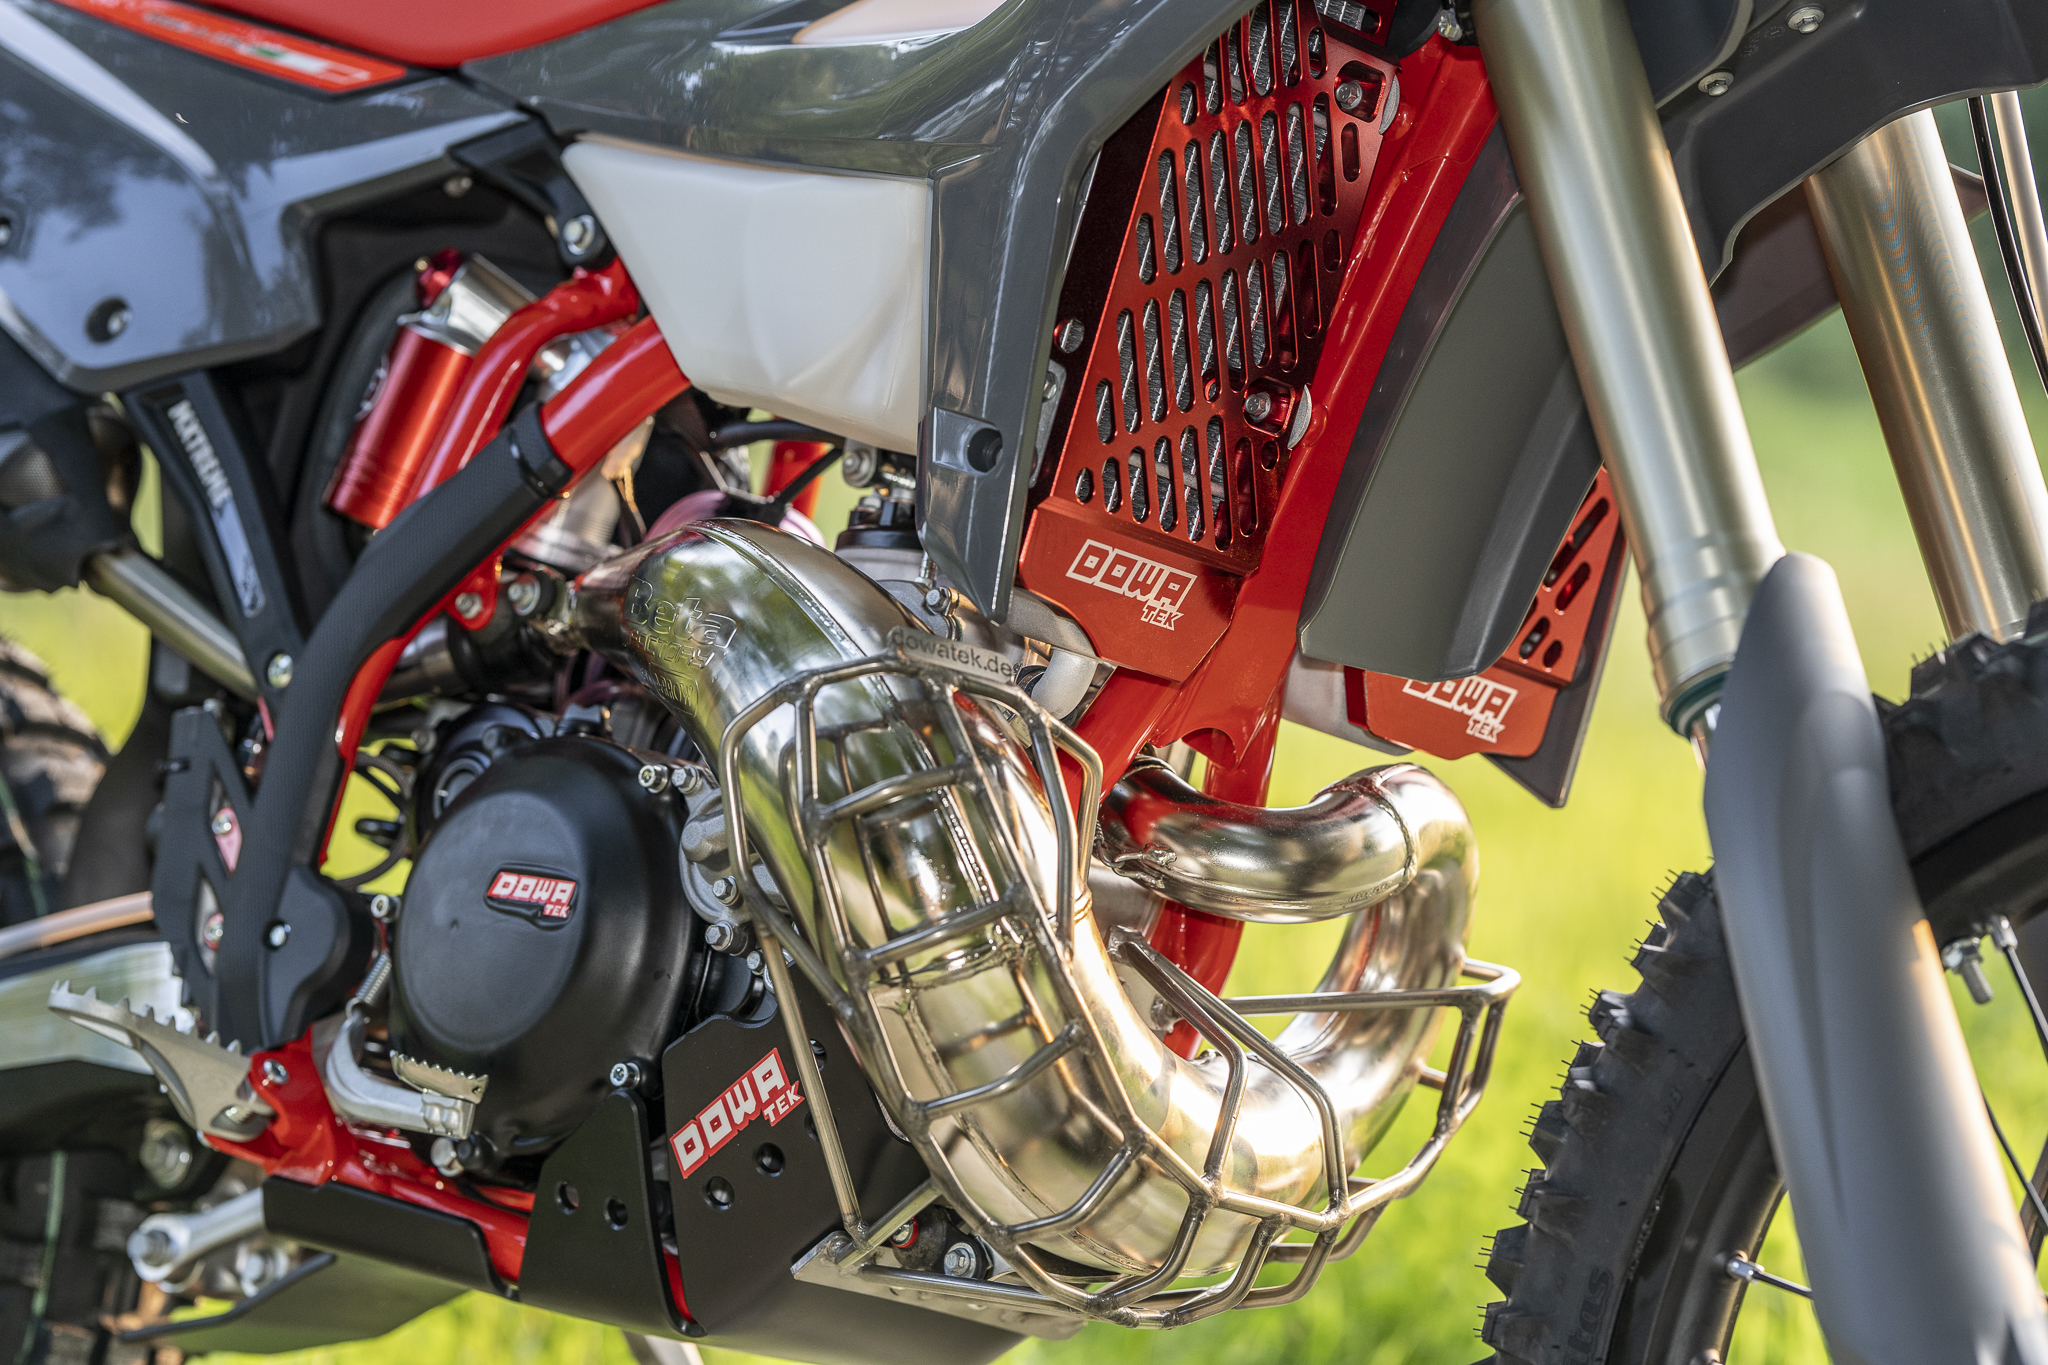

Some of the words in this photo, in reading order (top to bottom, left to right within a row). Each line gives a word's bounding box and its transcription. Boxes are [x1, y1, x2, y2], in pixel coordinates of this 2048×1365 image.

[1065, 538, 1198, 611] DOWA
[624, 574, 738, 649] Beta
[1140, 604, 1185, 632] TEK
[891, 627, 1013, 677] dowatek.de
[1466, 717, 1506, 744] TEK
[490, 873, 575, 904] DOWA
[543, 903, 571, 918] TEK
[672, 1052, 786, 1172] DOWA
[763, 1083, 801, 1124] TEK
